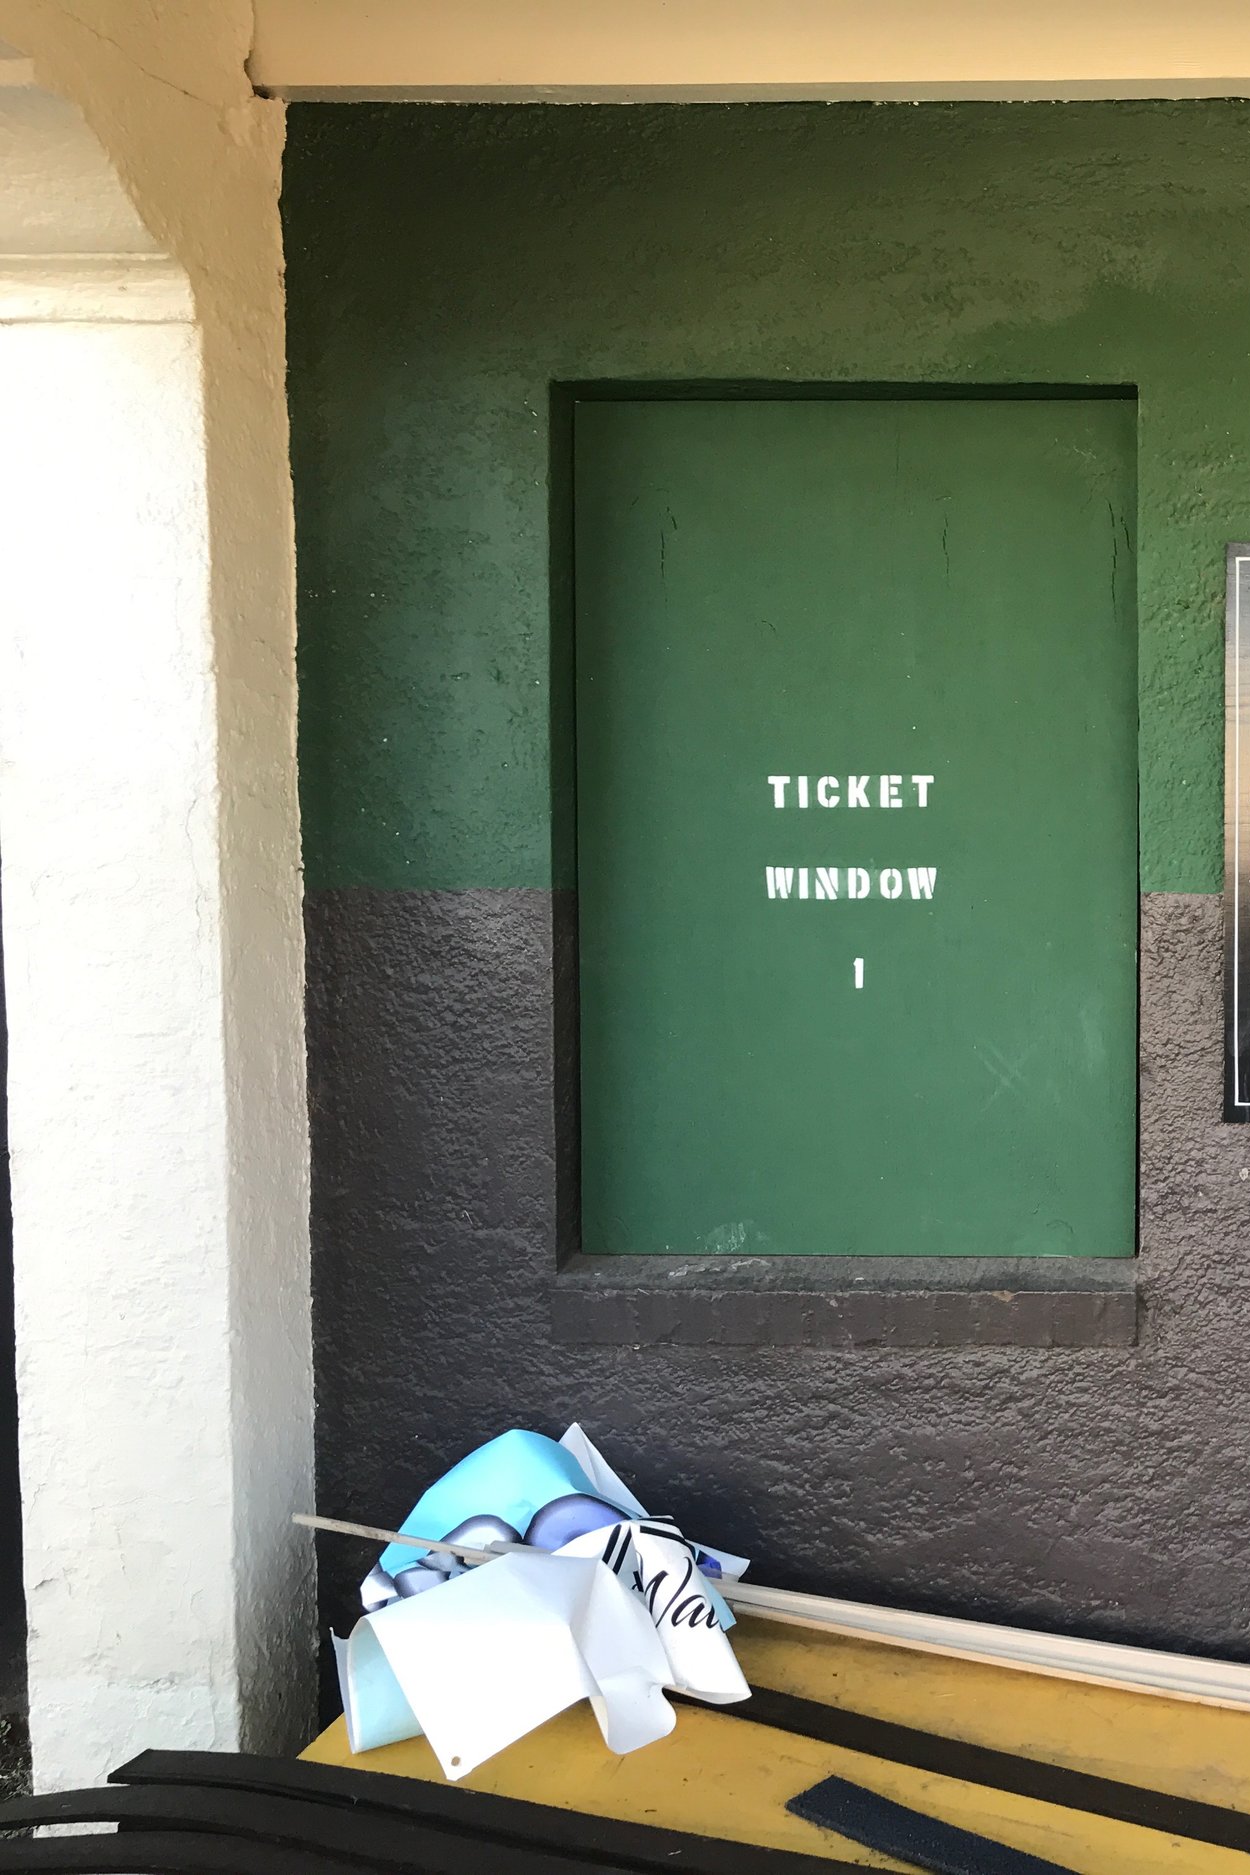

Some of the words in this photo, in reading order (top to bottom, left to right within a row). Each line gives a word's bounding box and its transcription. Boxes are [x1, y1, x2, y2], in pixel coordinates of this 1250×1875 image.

[768, 775, 934, 808] TICKET
[766, 866, 937, 900] WINDOW
[853, 957, 864, 989] 1
